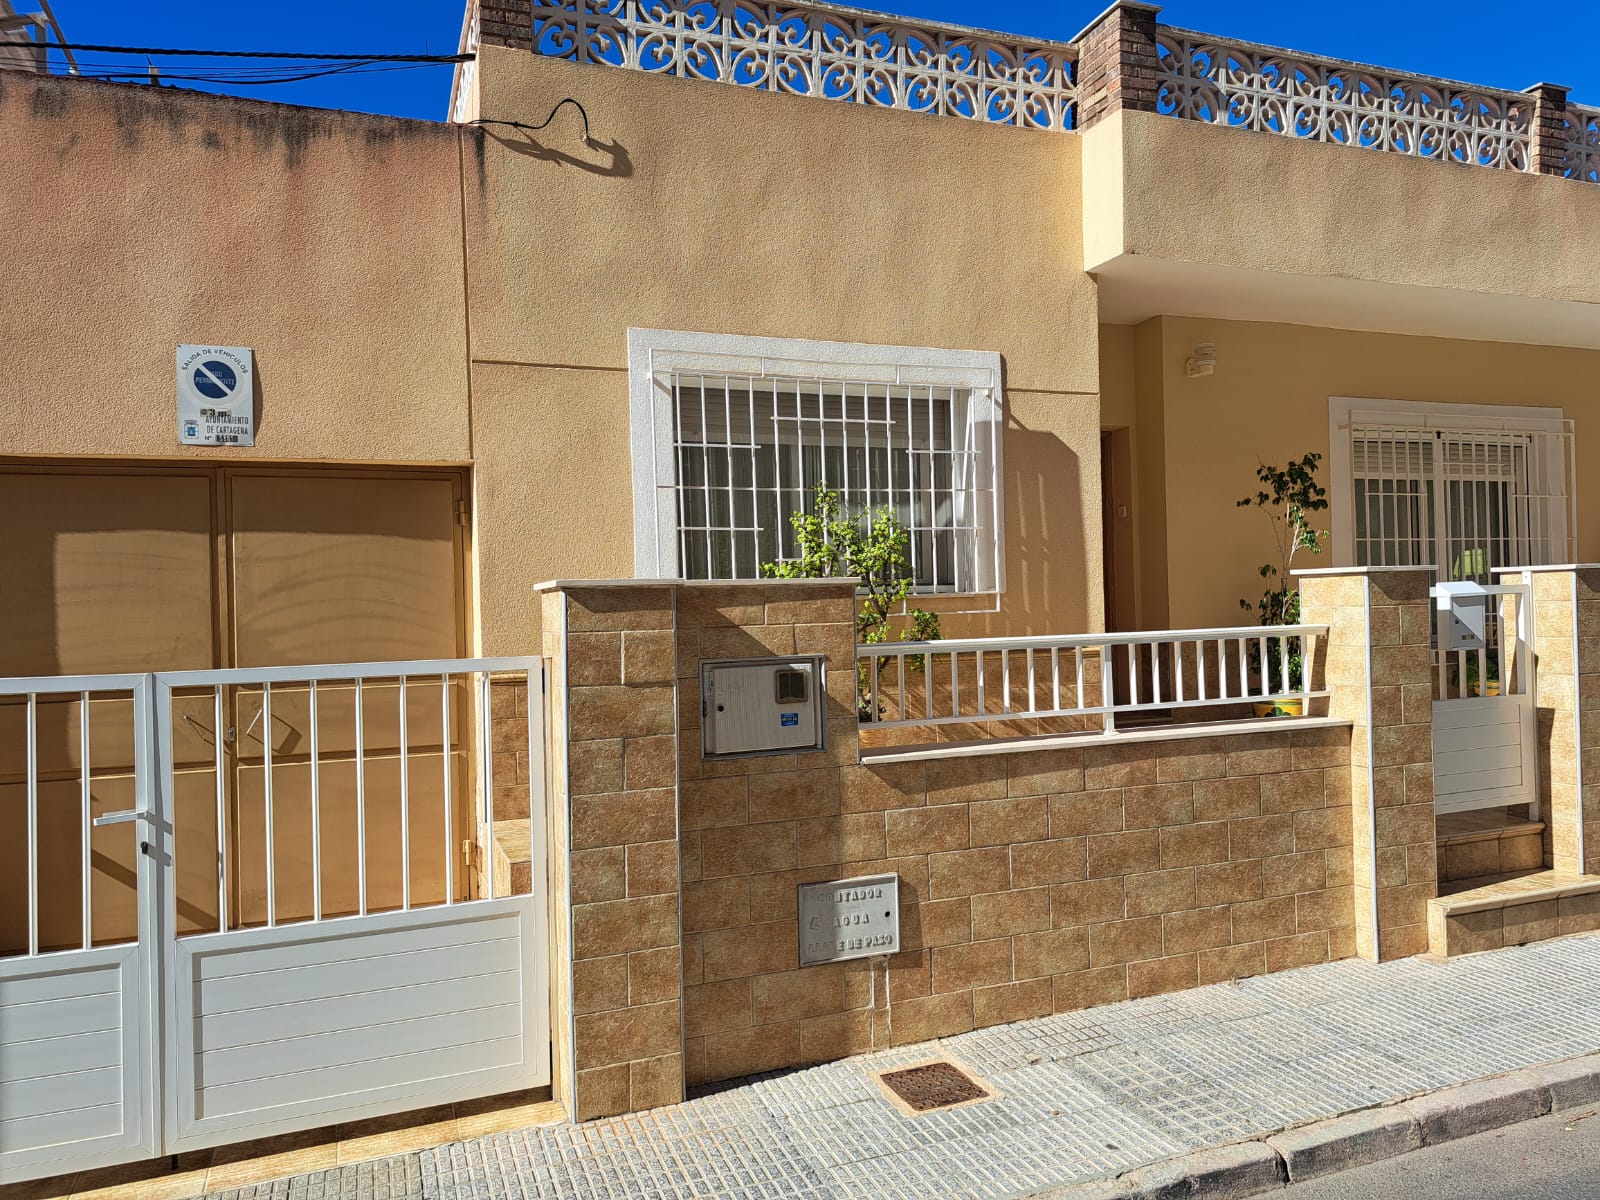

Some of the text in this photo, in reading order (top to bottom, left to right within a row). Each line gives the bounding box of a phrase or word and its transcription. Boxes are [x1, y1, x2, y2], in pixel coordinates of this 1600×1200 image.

[182, 352, 202, 371] SALIDA
[214, 349, 248, 374] VEHICULOS
[195, 377, 235, 385] PERMENTE
[205, 416, 249, 425] AYUNTAMIENTO
[206, 425, 249, 435] DE CARTAGENA
[831, 913, 870, 928] AGUA
[864, 934, 893, 948] PASO
